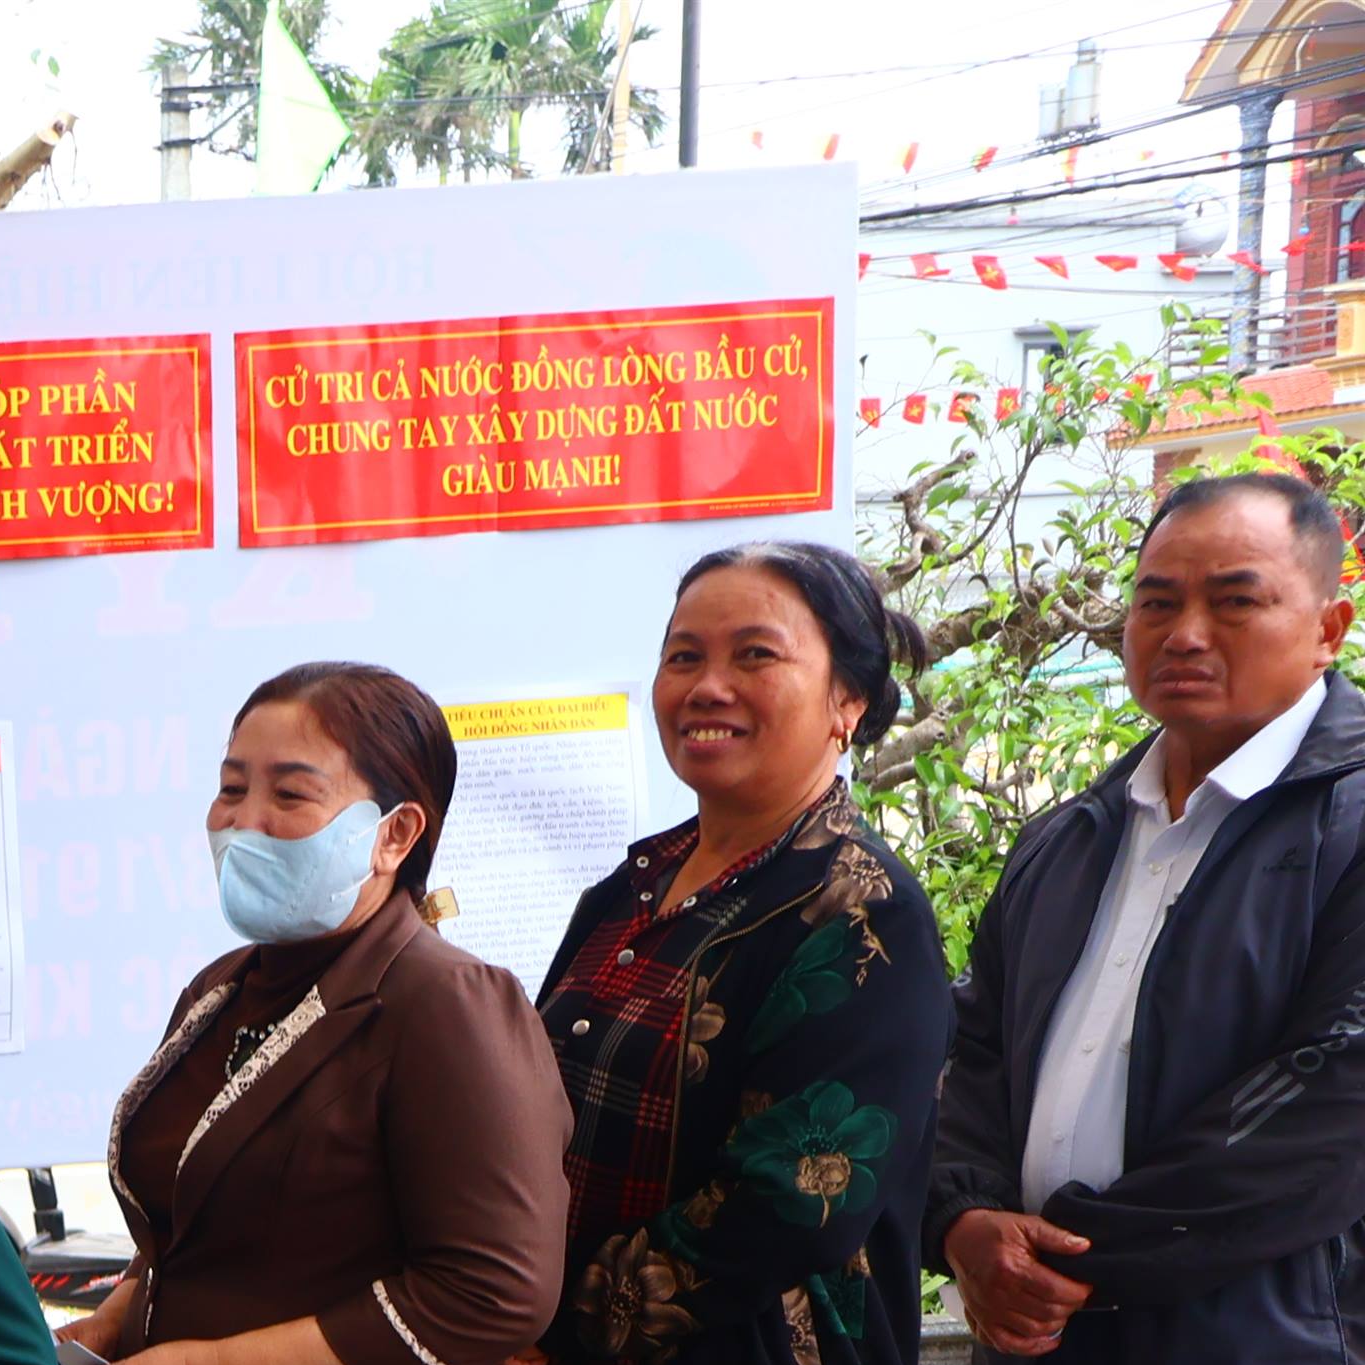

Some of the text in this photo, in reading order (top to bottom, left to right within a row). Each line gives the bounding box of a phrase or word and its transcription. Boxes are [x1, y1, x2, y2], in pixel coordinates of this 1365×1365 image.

[39, 367, 137, 416] PHẦN
[265, 333, 809, 409] CỬ TRI CẢ NƯỚC ĐỒNG LÒNG BẦU CỬ,
[46, 417, 154, 467] TRIỂN
[286, 387, 778, 457] CHUNG TAY XÂY DỰNG ĐẤT NƯỚC
[442, 454, 621, 497] GIÀU MẠNH!
[37, 480, 175, 524] VƯỢNG!
[447, 696, 610, 722] TIÊU CHUẨN CỦA ĐẠI BIỂU
[464, 716, 595, 738] HỘI ĐỒNG NHÂN DÂN
